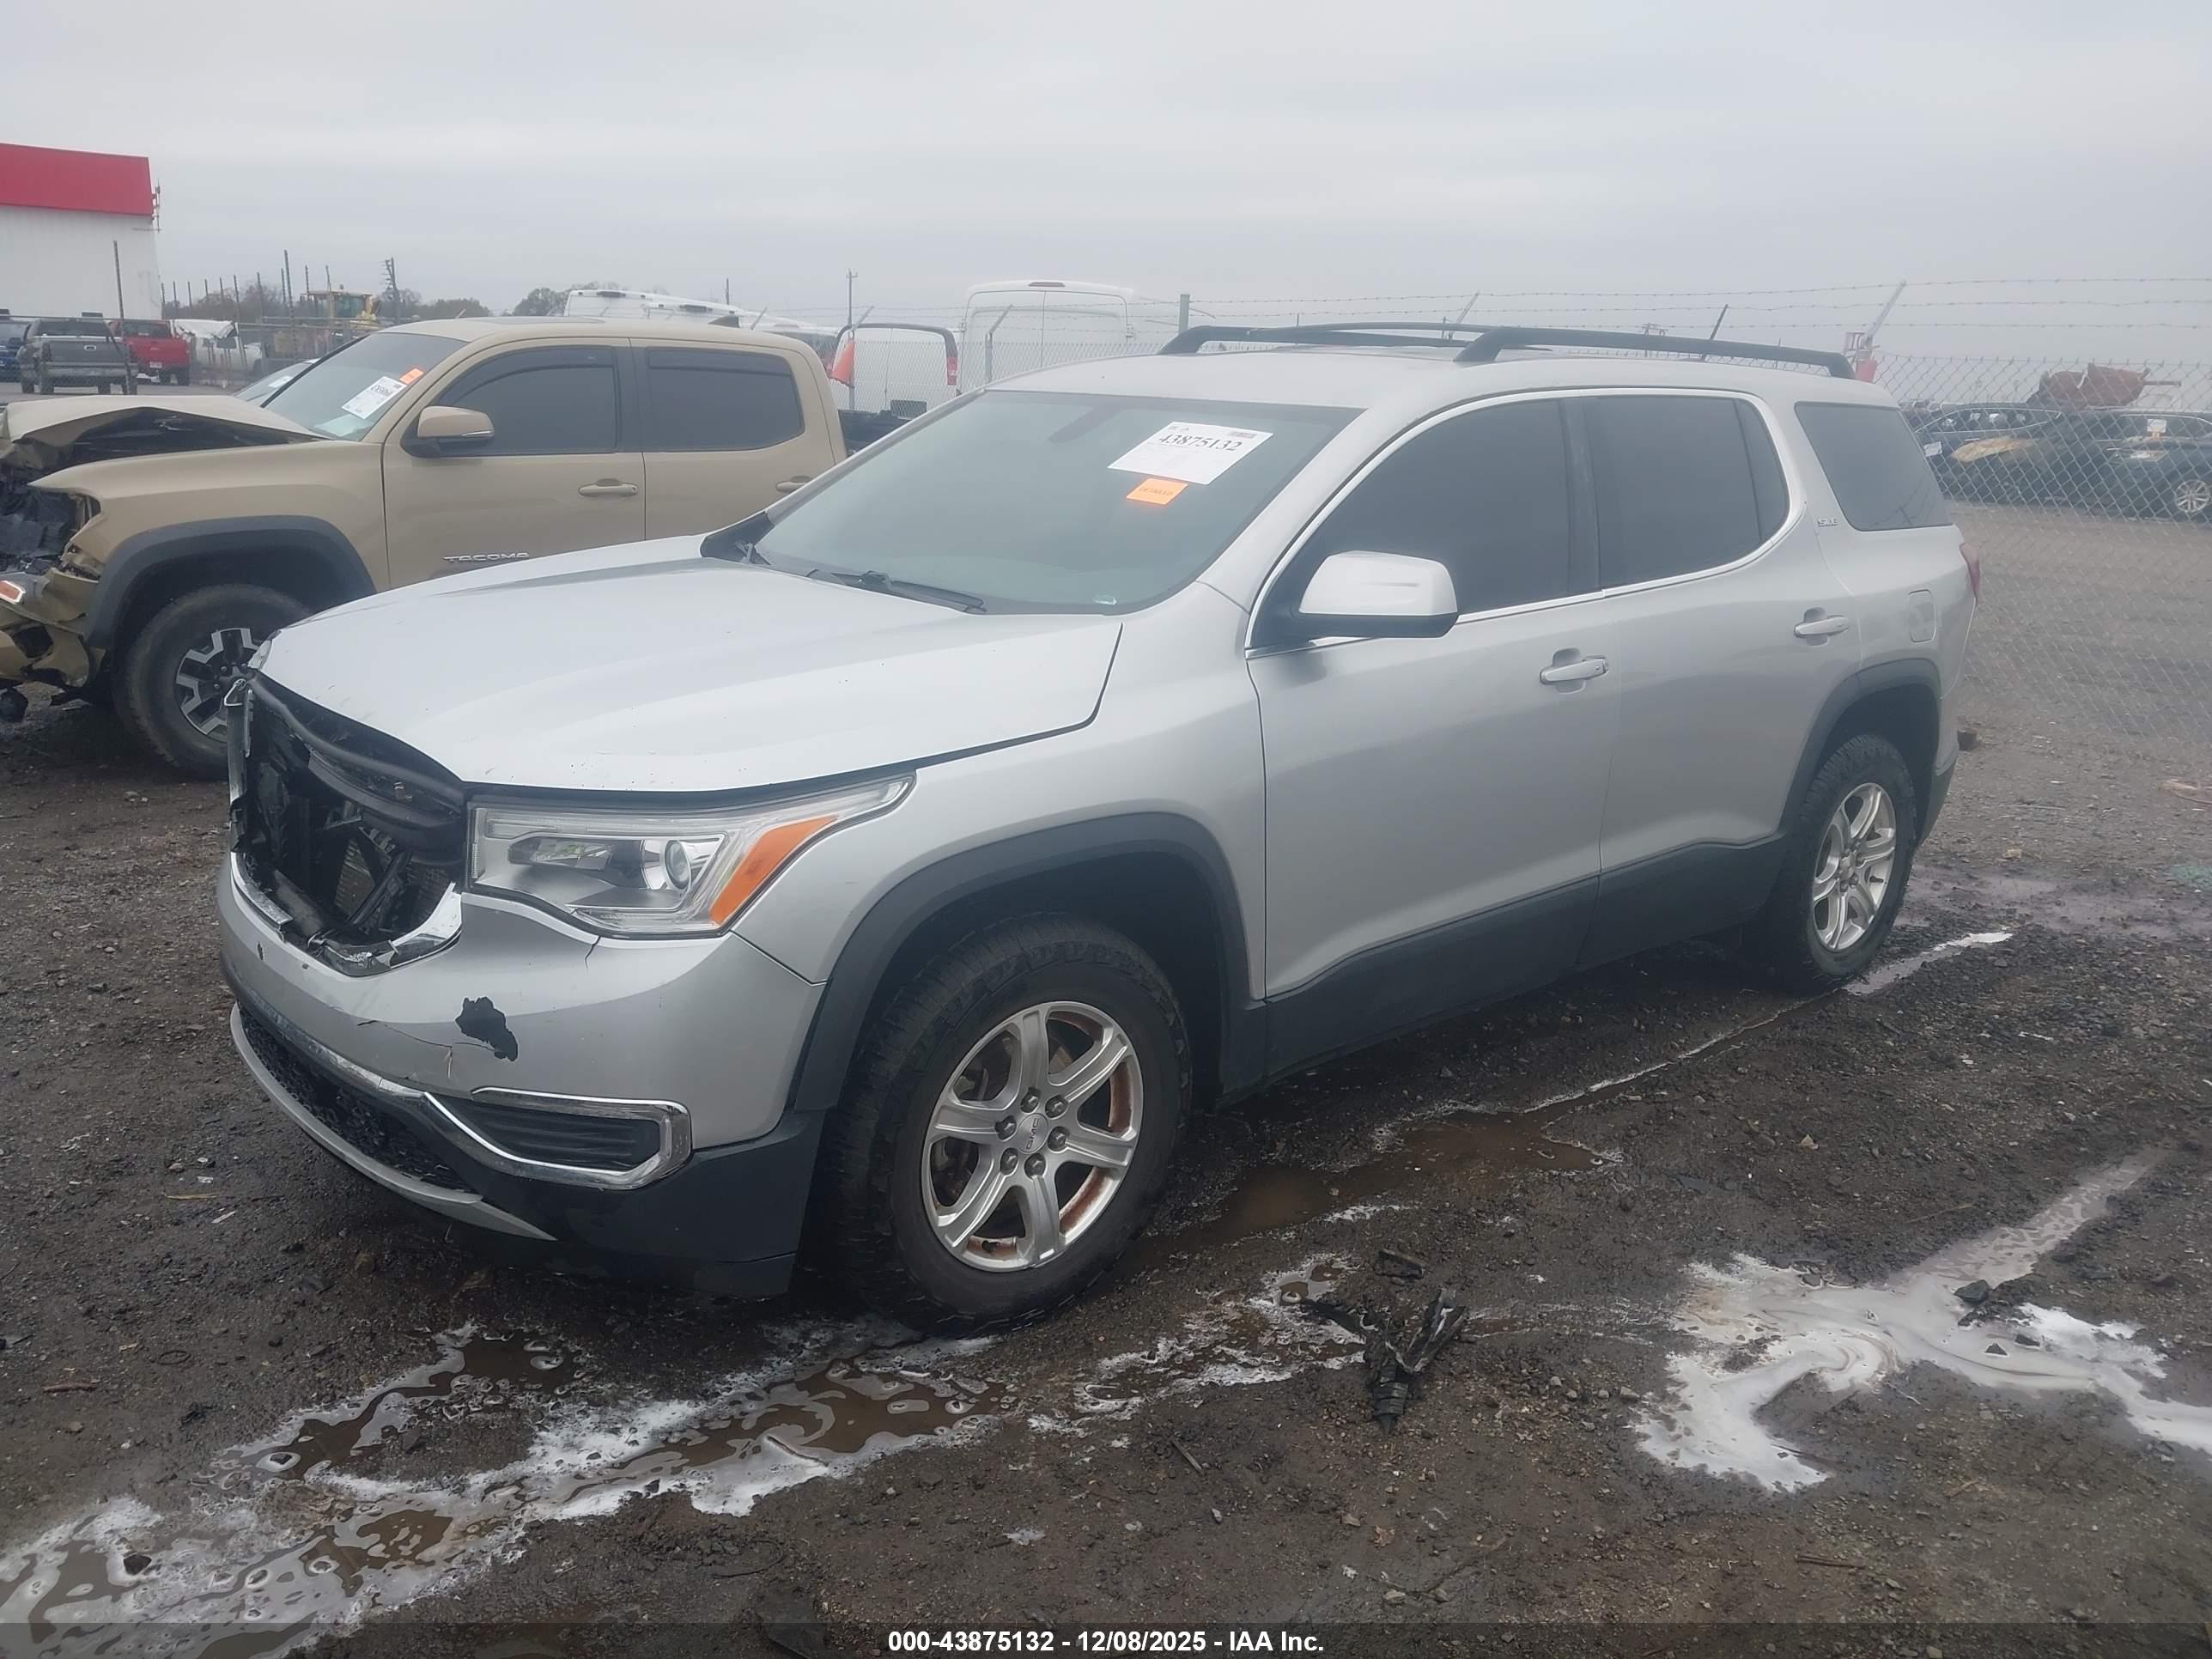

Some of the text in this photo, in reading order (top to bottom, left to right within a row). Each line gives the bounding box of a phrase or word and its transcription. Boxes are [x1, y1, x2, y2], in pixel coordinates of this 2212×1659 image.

[1158, 433, 1243, 452] 43875132
[442, 552, 530, 563] TACOMA
[1025, 1116, 1040, 1150] GMC
